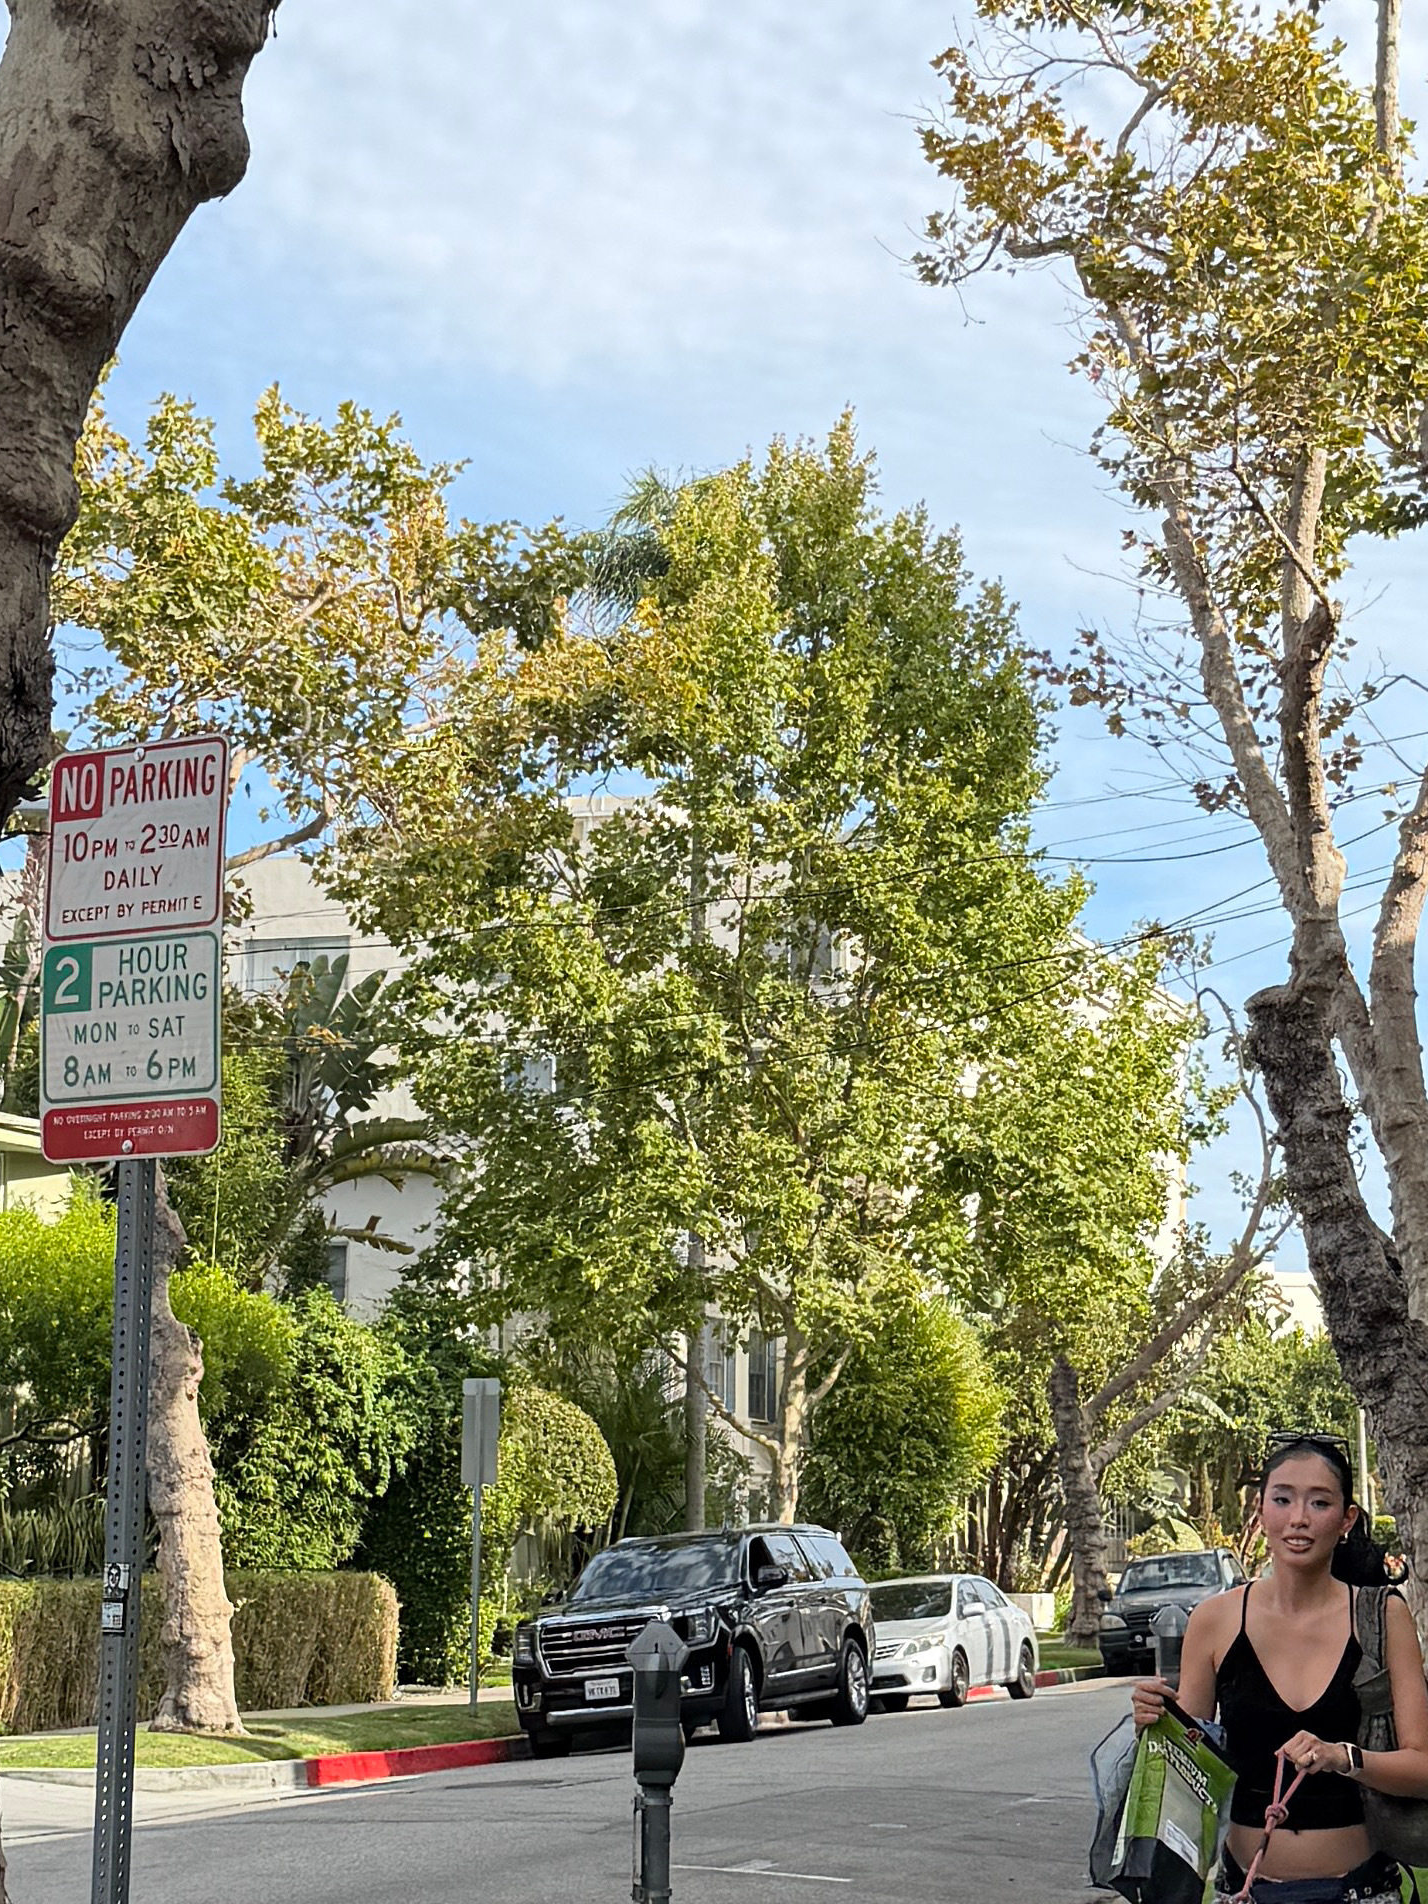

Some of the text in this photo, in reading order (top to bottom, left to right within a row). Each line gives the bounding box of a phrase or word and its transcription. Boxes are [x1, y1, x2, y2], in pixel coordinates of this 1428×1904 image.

[59, 754, 216, 814] NO PARKING
[104, 864, 163, 891] DAILY
[62, 905, 110, 924] EXCEPT
[117, 903, 135, 918] BY
[141, 897, 188, 916] PERMIT
[119, 944, 188, 976] HOUR
[54, 956, 80, 1005] 2
[99, 972, 207, 1008] PARKING
[74, 1016, 185, 1045] MON TO SAT
[126, 1066, 137, 1077] TO
[53, 1116, 64, 1126] NO
[110, 1109, 142, 1121] PARKING
[83, 1128, 111, 1140] EXCEPT
[114, 1128, 124, 1138] BY
[573, 1626, 625, 1642] GMC
